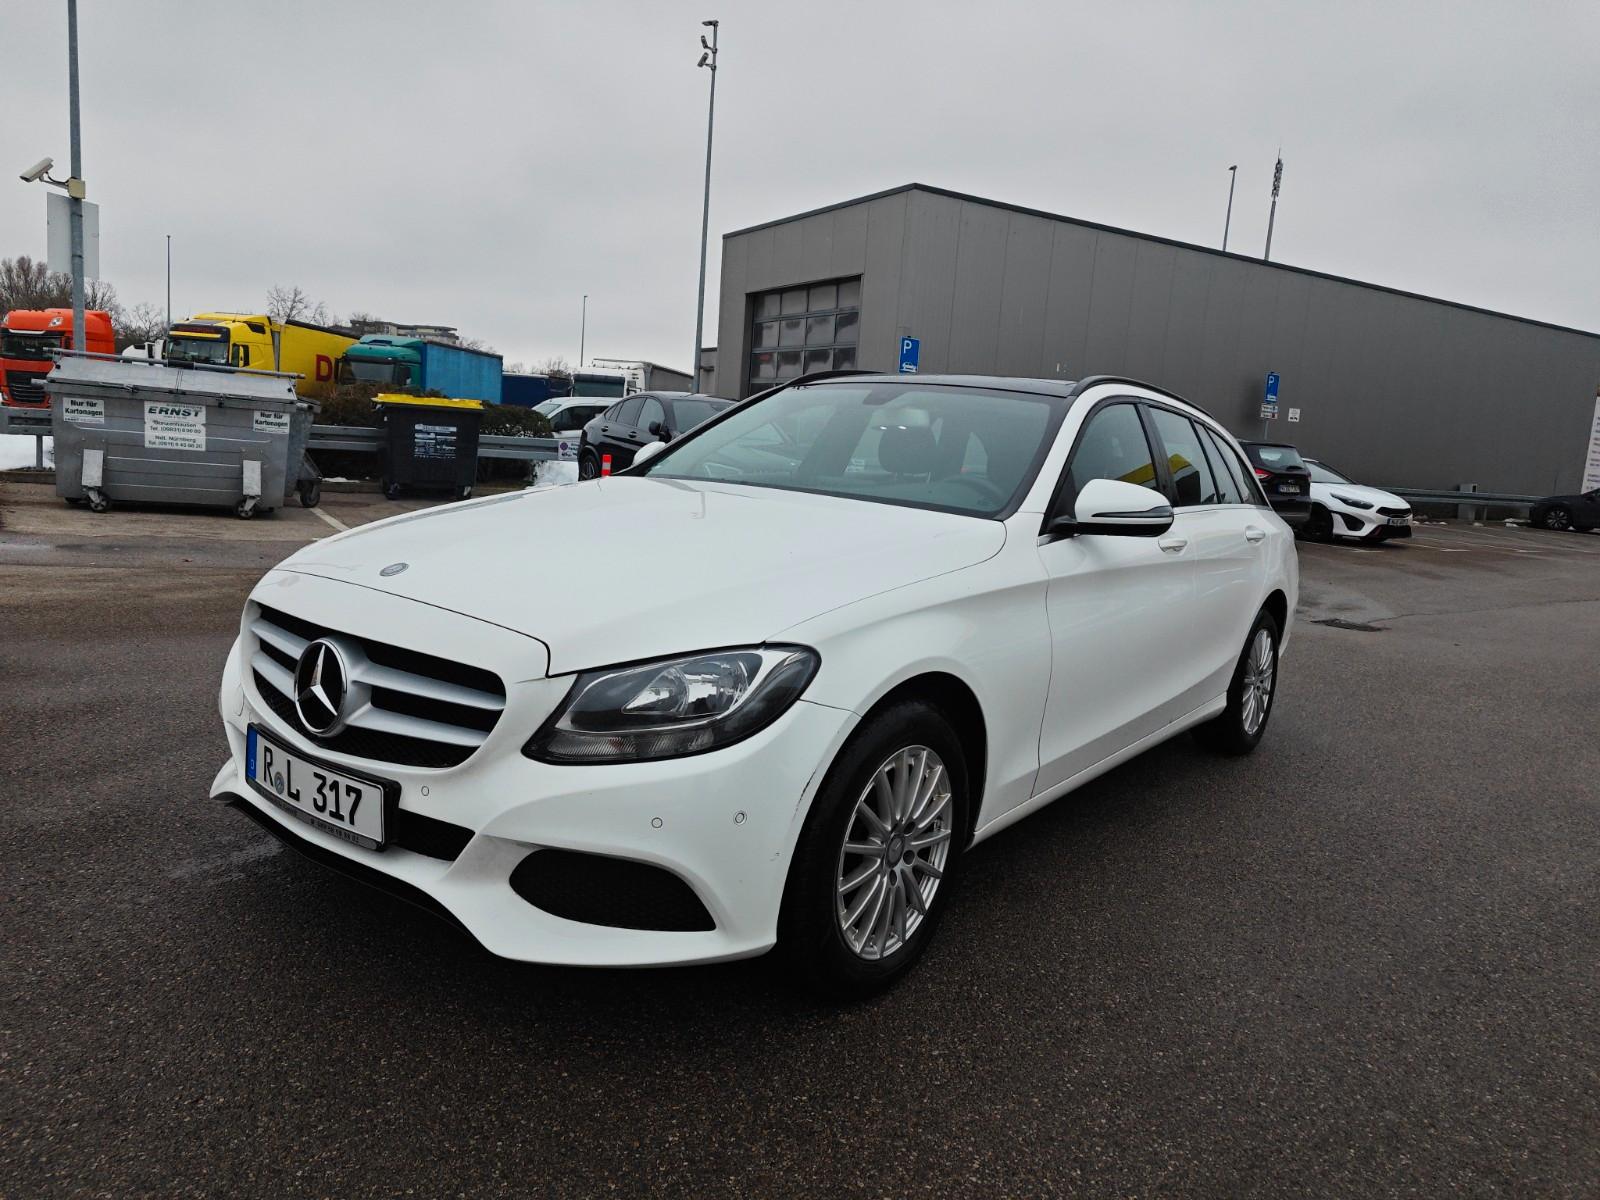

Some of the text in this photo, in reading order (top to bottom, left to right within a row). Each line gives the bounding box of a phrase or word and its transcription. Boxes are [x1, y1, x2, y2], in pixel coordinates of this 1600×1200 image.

[903, 340, 912, 354] P
[64, 408, 103, 417] Kartonagen
[148, 406, 202, 417] ERNST
[264, 745, 274, 787] R
[286, 759, 300, 802] L
[312, 771, 362, 826] 317
